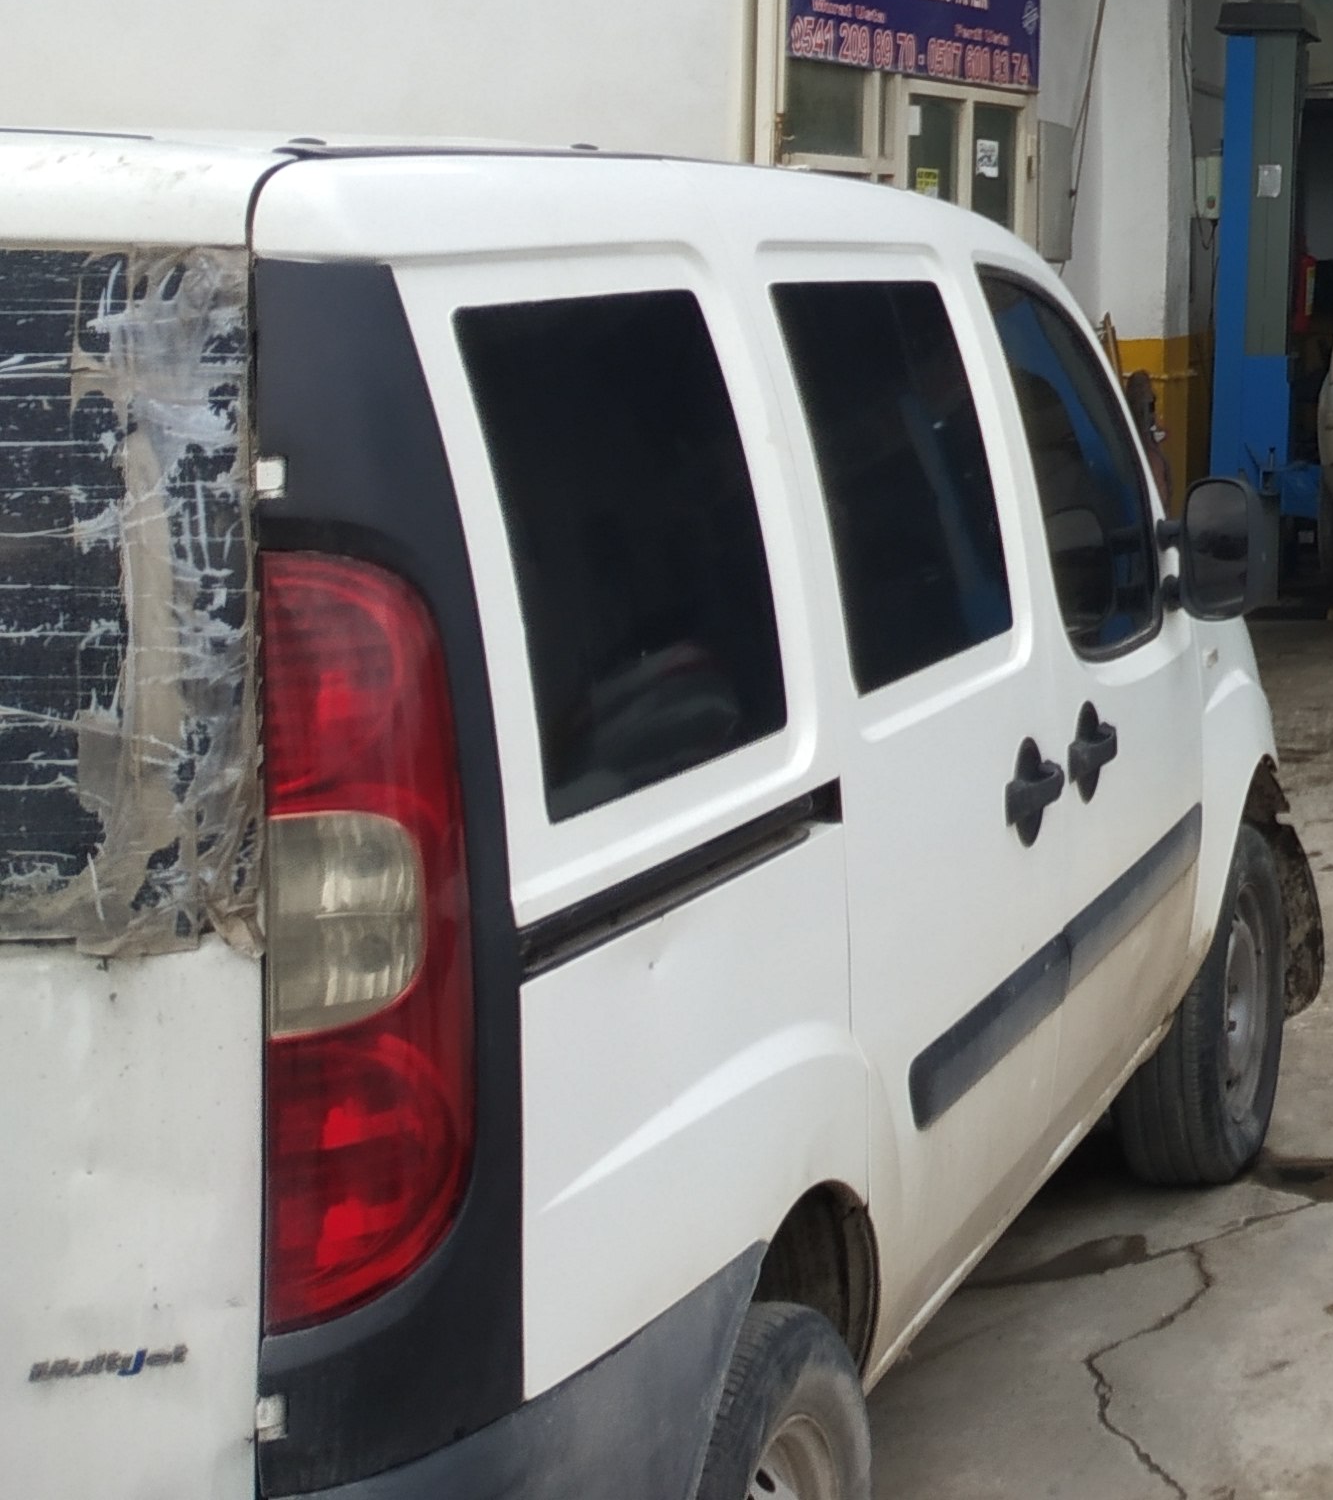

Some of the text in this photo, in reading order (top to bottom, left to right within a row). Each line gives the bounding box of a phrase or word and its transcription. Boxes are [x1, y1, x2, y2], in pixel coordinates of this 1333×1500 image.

[791, 15, 834, 60] 0541
[839, 22, 869, 66] 209
[873, 29, 893, 70] 89
